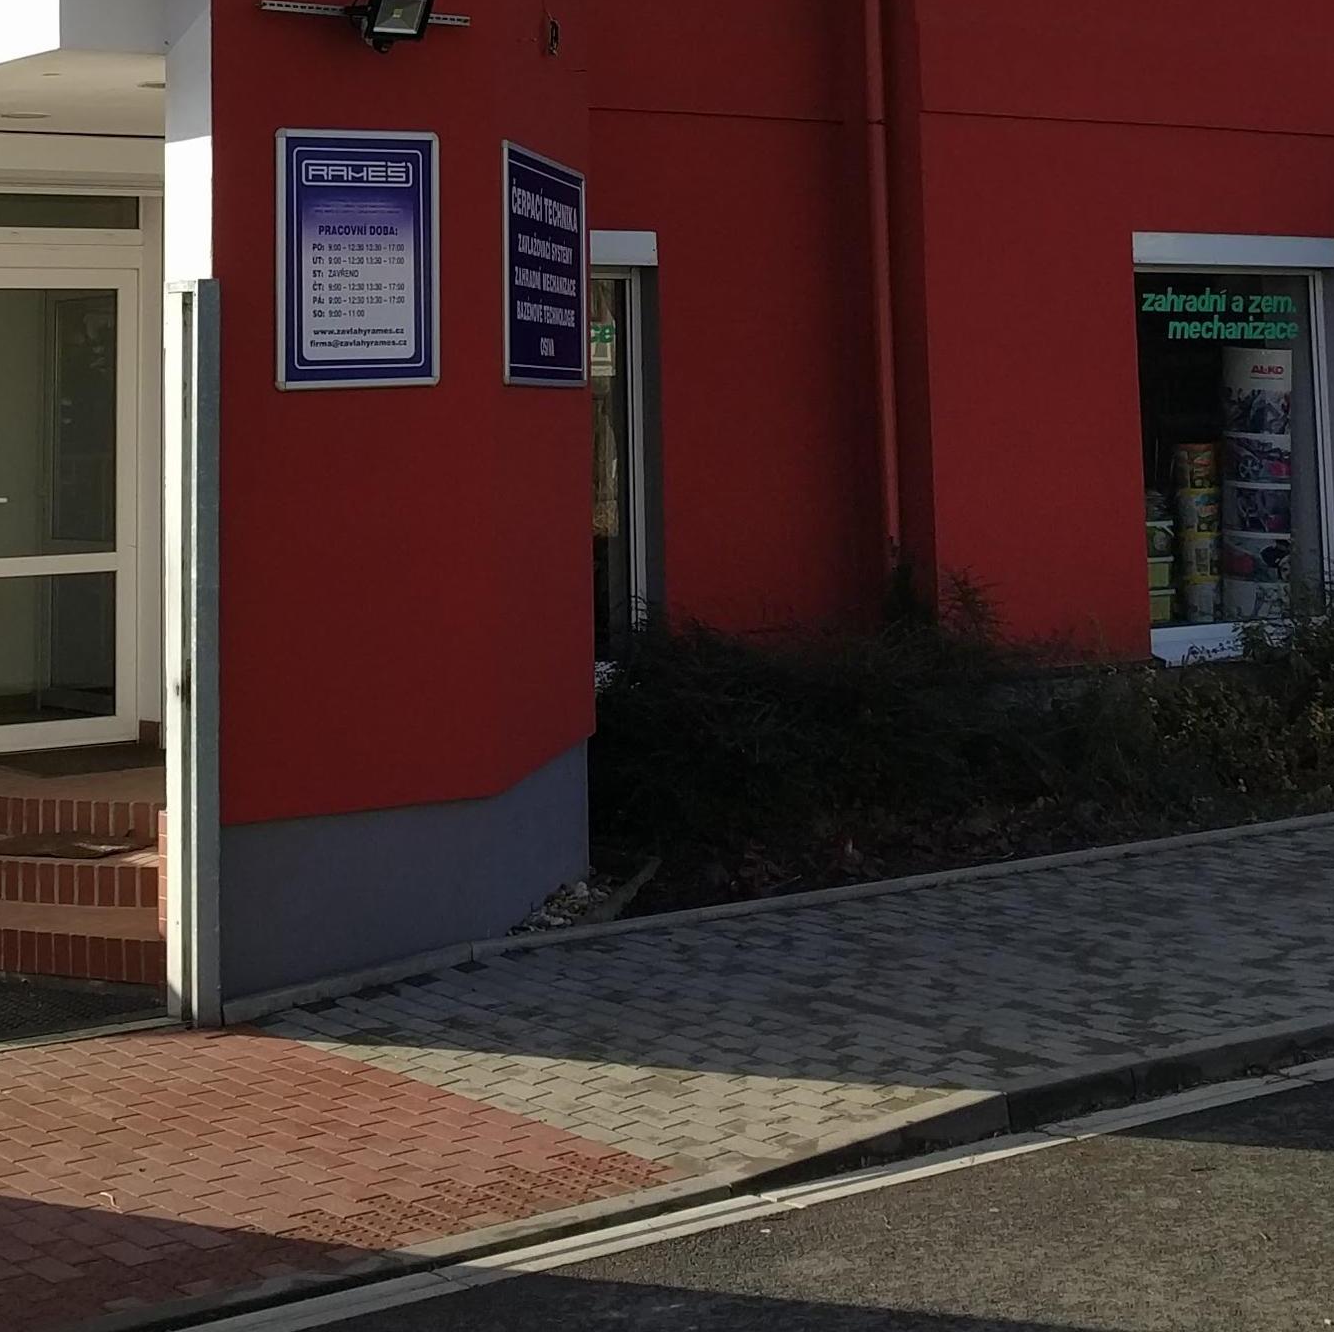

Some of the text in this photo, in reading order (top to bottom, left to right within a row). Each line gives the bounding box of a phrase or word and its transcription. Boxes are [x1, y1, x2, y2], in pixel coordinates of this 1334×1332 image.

[512, 177, 578, 234] ČERPACÍ TECHNIKA
[318, 224, 398, 236] PRACOVNÍ DOBA:
[312, 243, 324, 252] PO:
[312, 267, 359, 278] ST: ZAVŘENO
[1141, 286, 1297, 313] zahradní a zem.
[312, 309, 325, 318] SO:
[313, 327, 404, 336] www.zavlahyrames.cz
[1167, 314, 1300, 340] mechanizace
[310, 339, 407, 348] firma@zavlahyrames.cz
